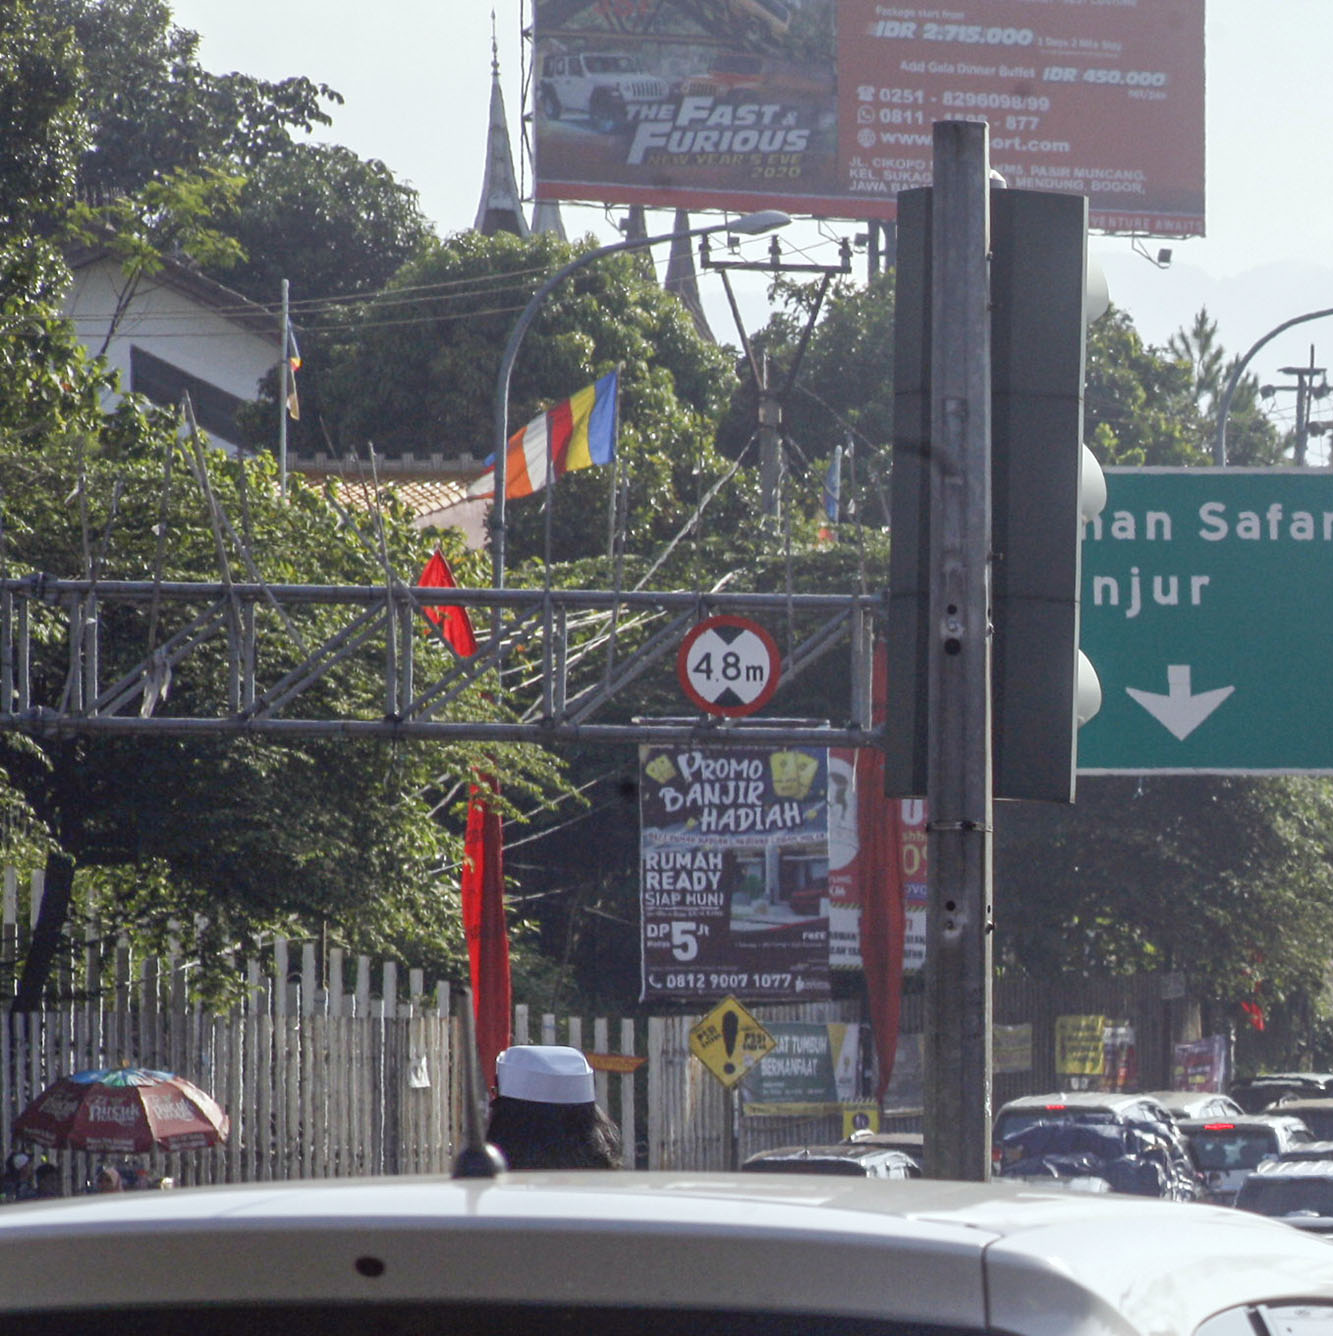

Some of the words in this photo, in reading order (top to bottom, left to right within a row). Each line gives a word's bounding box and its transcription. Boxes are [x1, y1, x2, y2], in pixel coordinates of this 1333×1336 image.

[872, 20, 916, 40] IDR
[900, 59, 927, 73] Add
[956, 63, 997, 77] Dinner
[1043, 66, 1077, 83] IDR
[1083, 69, 1167, 88] 450.000
[879, 88, 924, 102] 0251
[624, 104, 676, 121] THE
[675, 96, 780, 127] FAST
[879, 108, 924, 124] 0811
[1006, 115, 1040, 131] 877
[626, 121, 811, 165] FURIOUS
[752, 166, 801, 179] 2020
[883, 168, 934, 183] SUKAG
[849, 181, 897, 193] JAWA
[1092, 566, 1211, 619] njur
[676, 751, 764, 783] PROMO
[658, 780, 765, 813] BANJIR
[701, 801, 802, 833] HADIAH
[645, 852, 723, 870] RUMAH
[645, 871, 722, 891] READY
[645, 892, 682, 907] SIAP
[686, 892, 724, 906] HUNI
[646, 923, 670, 938] DP
[671, 920, 698, 962] 5
[666, 973, 706, 989] 0812
[710, 973, 748, 988] 9007
[753, 973, 792, 988] 1077
